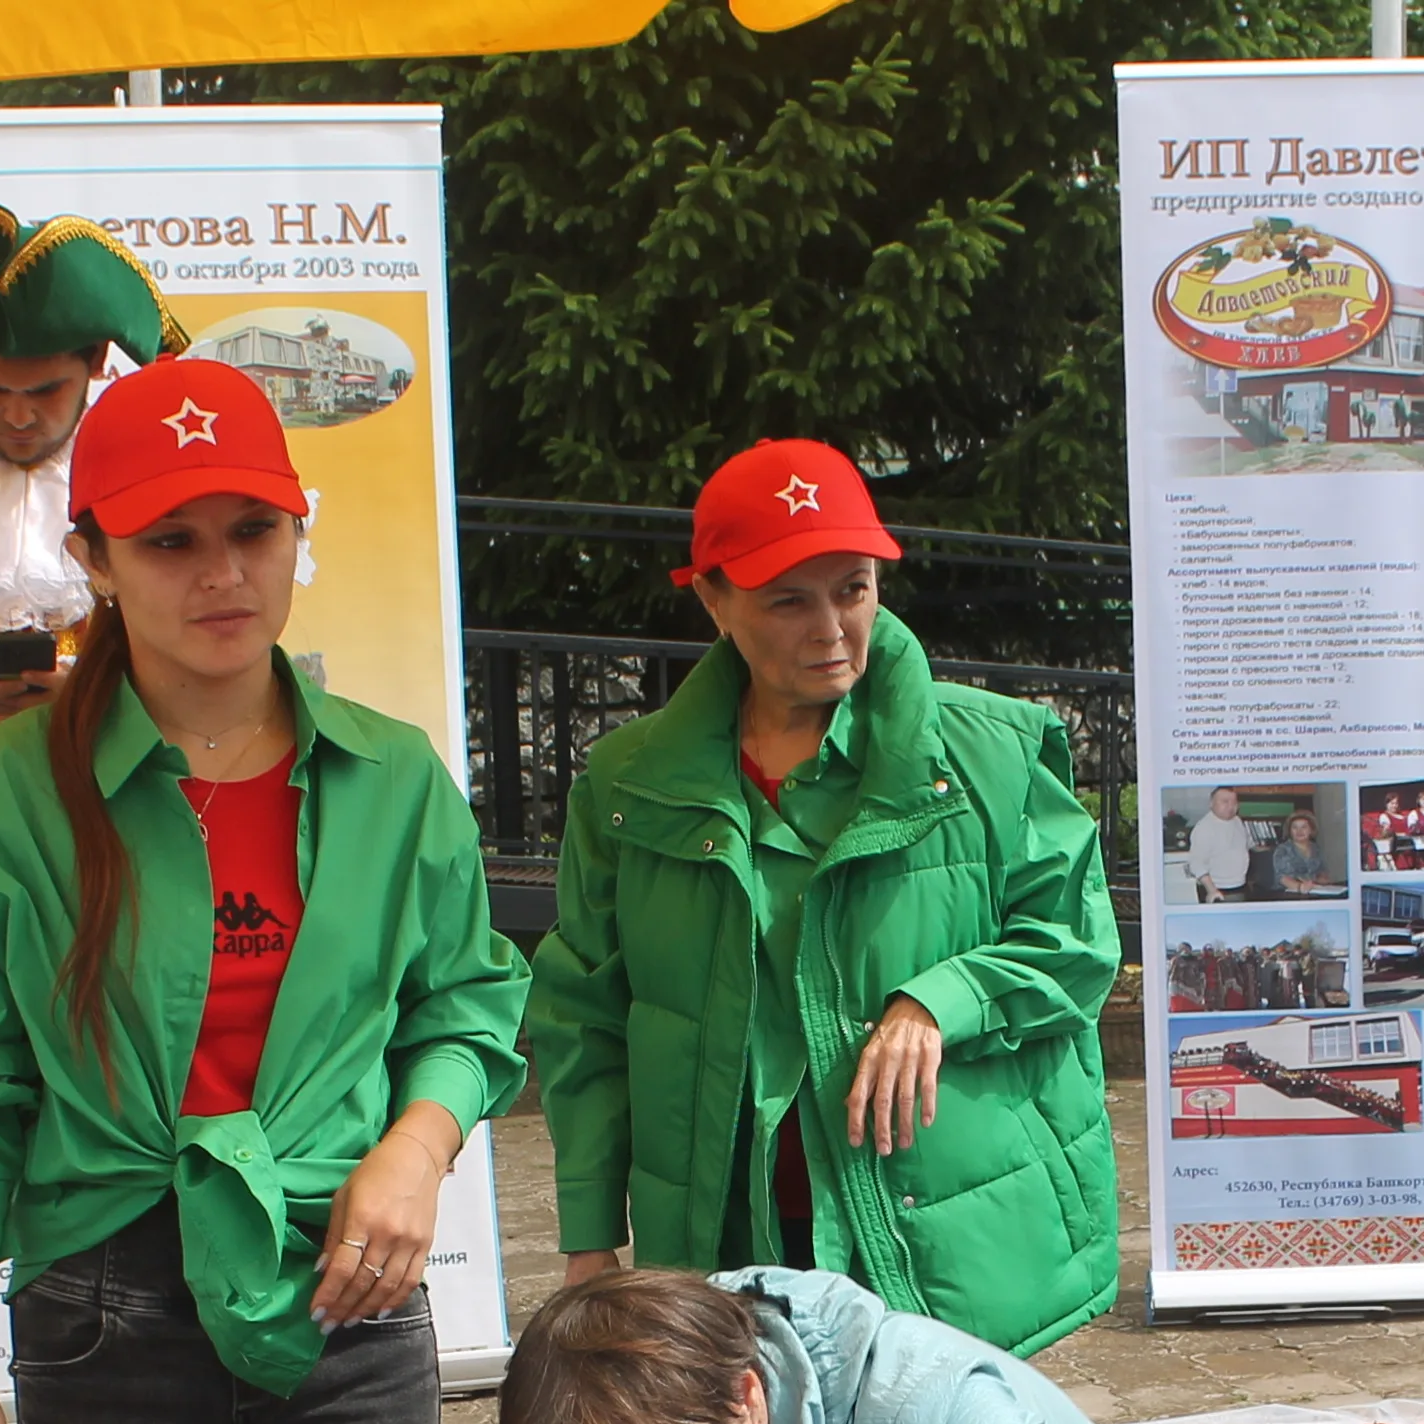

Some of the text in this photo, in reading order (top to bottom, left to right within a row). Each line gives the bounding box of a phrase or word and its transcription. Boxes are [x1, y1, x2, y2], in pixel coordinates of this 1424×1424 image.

[1161, 139, 1250, 178] ИП
[1151, 191, 1317, 216] предприятие
[1324, 190, 1423, 209] создано
[267, 203, 407, 247] Н.М.
[175, 256, 286, 284] октября
[294, 257, 353, 278] 2003
[363, 259, 419, 280] года
[1218, 579, 1230, 588] 14
[1172, 1166, 1218, 1180] Адрес:
[1225, 1180, 1277, 1193] 452630,
[1281, 1178, 1363, 1192] Республика
[1278, 1197, 1310, 1209] Тел.:
[1314, 1194, 1364, 1207] (34769)
[1368, 1193, 1422, 1206] 3-03-98,
